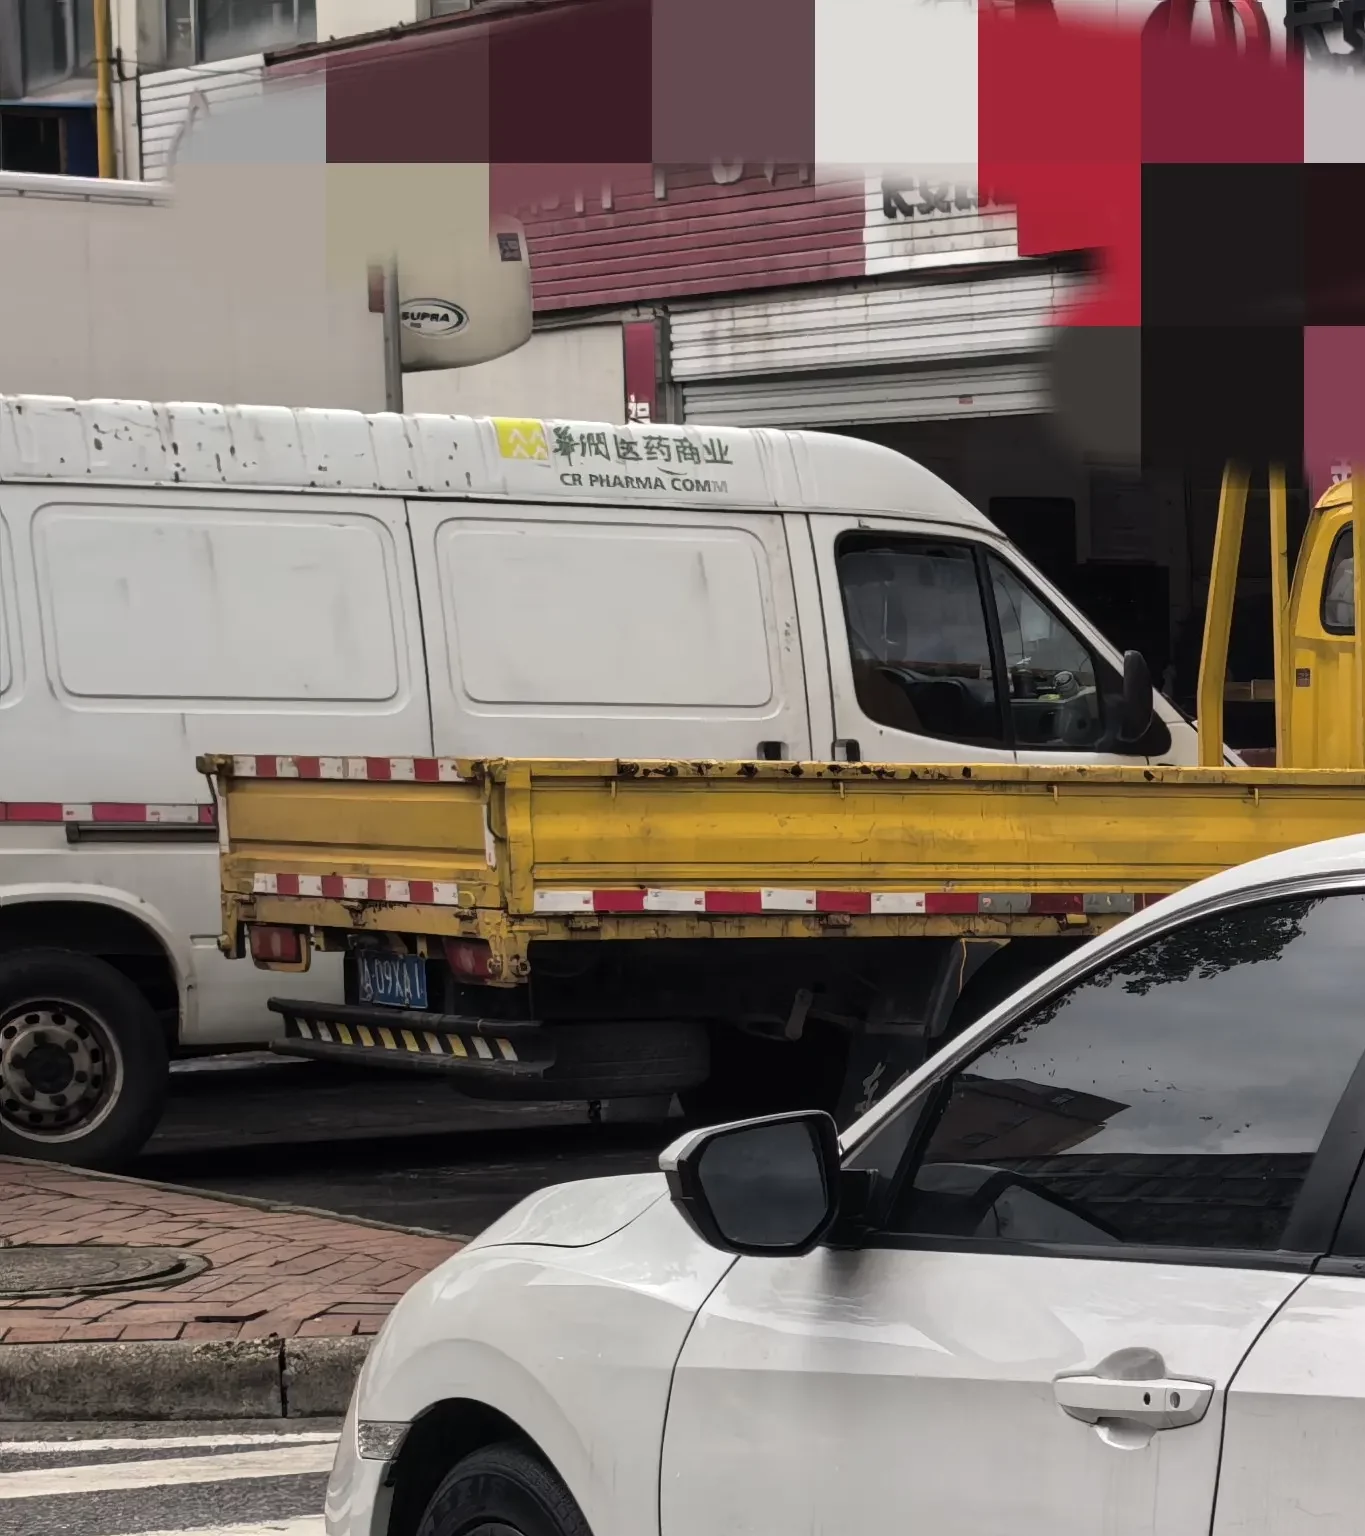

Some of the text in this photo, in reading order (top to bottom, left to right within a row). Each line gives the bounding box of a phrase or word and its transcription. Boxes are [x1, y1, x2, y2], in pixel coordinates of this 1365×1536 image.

[401, 311, 450, 323] SUPRA
[560, 473, 583, 487] CR
[589, 474, 667, 491] PHARMA
